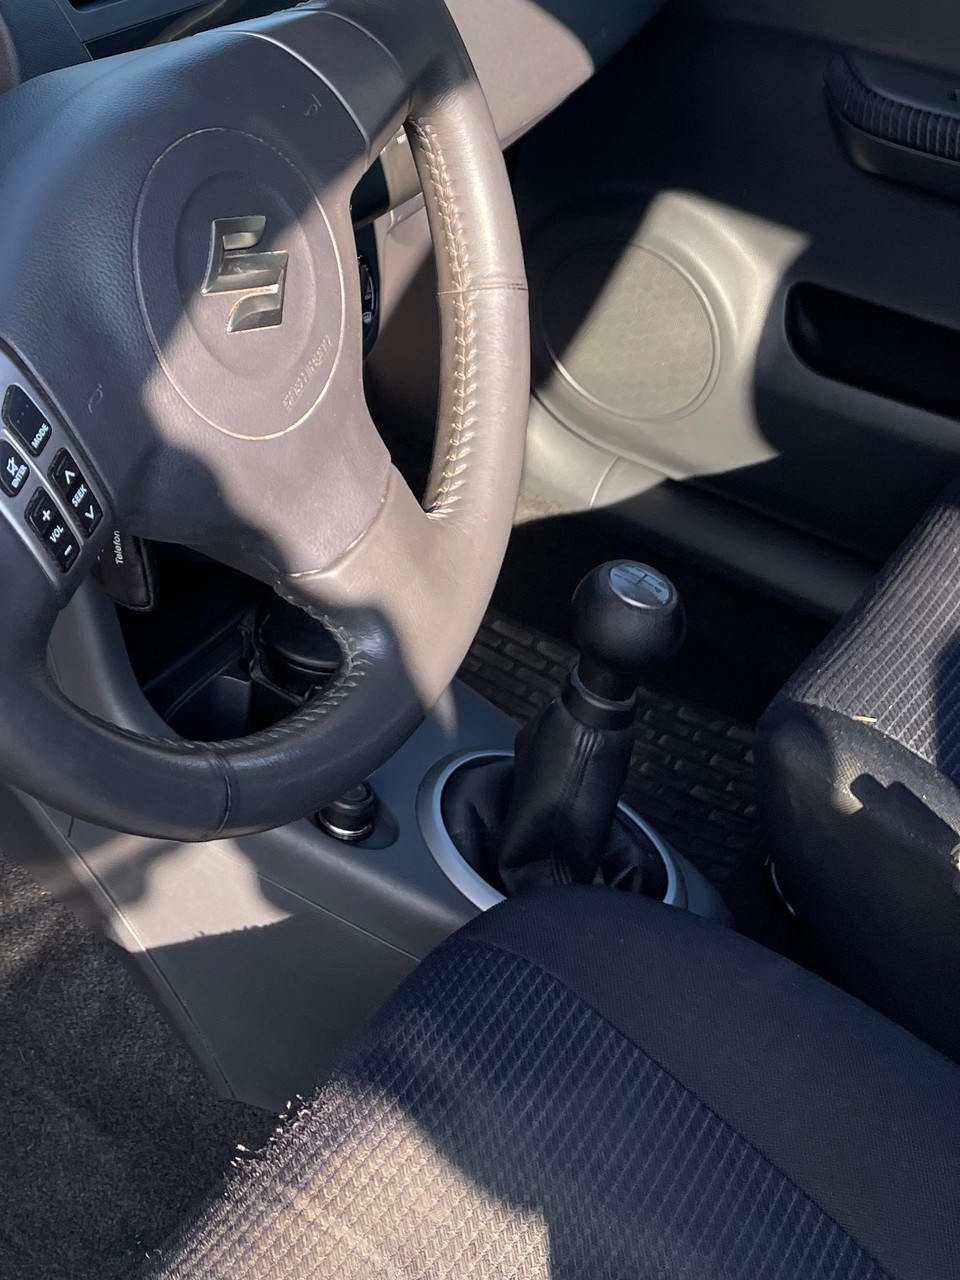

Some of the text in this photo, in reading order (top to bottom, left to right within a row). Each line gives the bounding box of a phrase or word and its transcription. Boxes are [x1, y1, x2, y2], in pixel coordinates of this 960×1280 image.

[31, 422, 50, 449] MODE
[11, 464, 28, 489] ENTER
[71, 483, 88, 508] SEEK
[49, 524, 65, 544] VOL
[112, 530, 125, 565] Telefon
